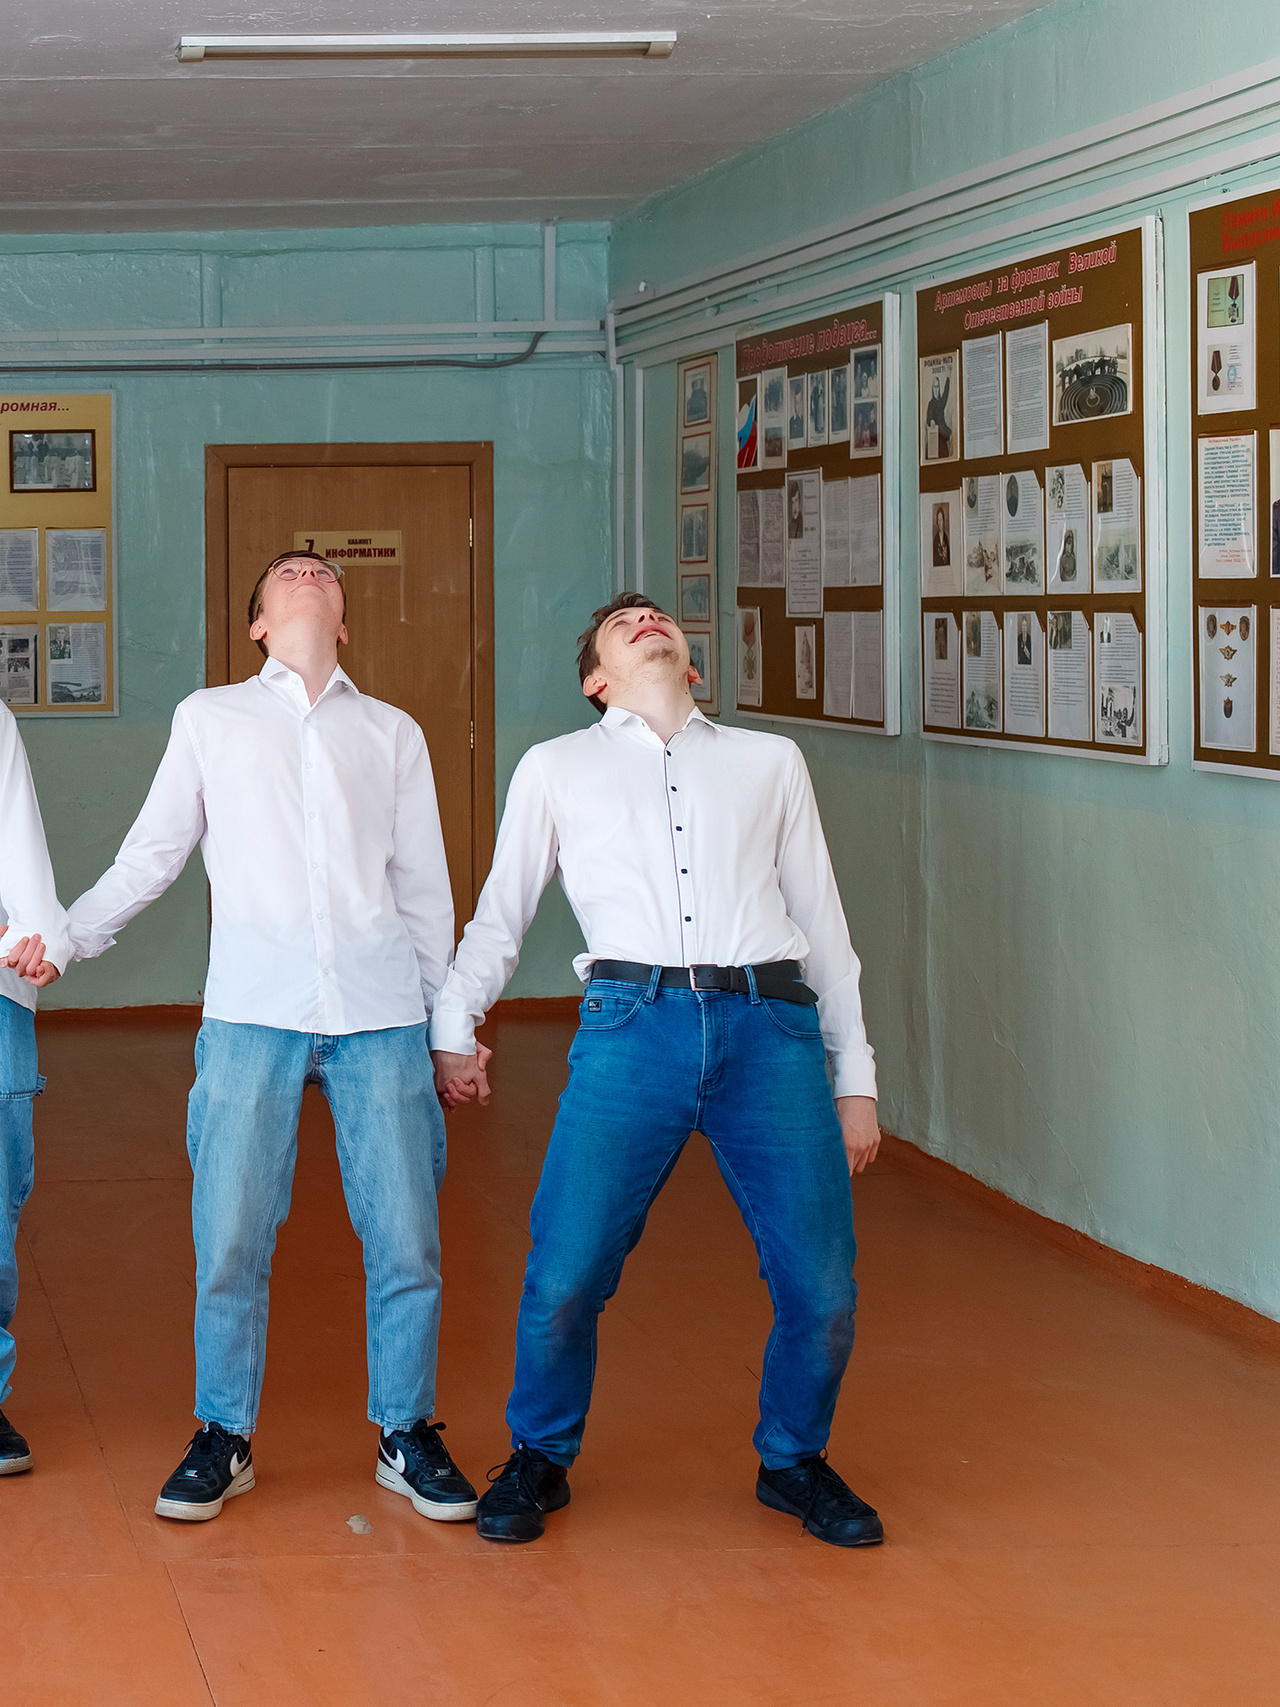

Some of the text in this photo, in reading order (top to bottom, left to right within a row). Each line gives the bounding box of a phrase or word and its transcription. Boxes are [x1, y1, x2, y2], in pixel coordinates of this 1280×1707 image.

[1223, 206, 1269, 230] Памяти
[1223, 225, 1280, 252] Выпускни
[934, 240, 1117, 314] Артемовцы на фронтах Великой
[964, 284, 1083, 330] Отечественной войны
[741, 333, 816, 371] Продолжение
[305, 539, 315, 553] 7
[325, 548, 396, 559] ИНФОРМАТИКИ
